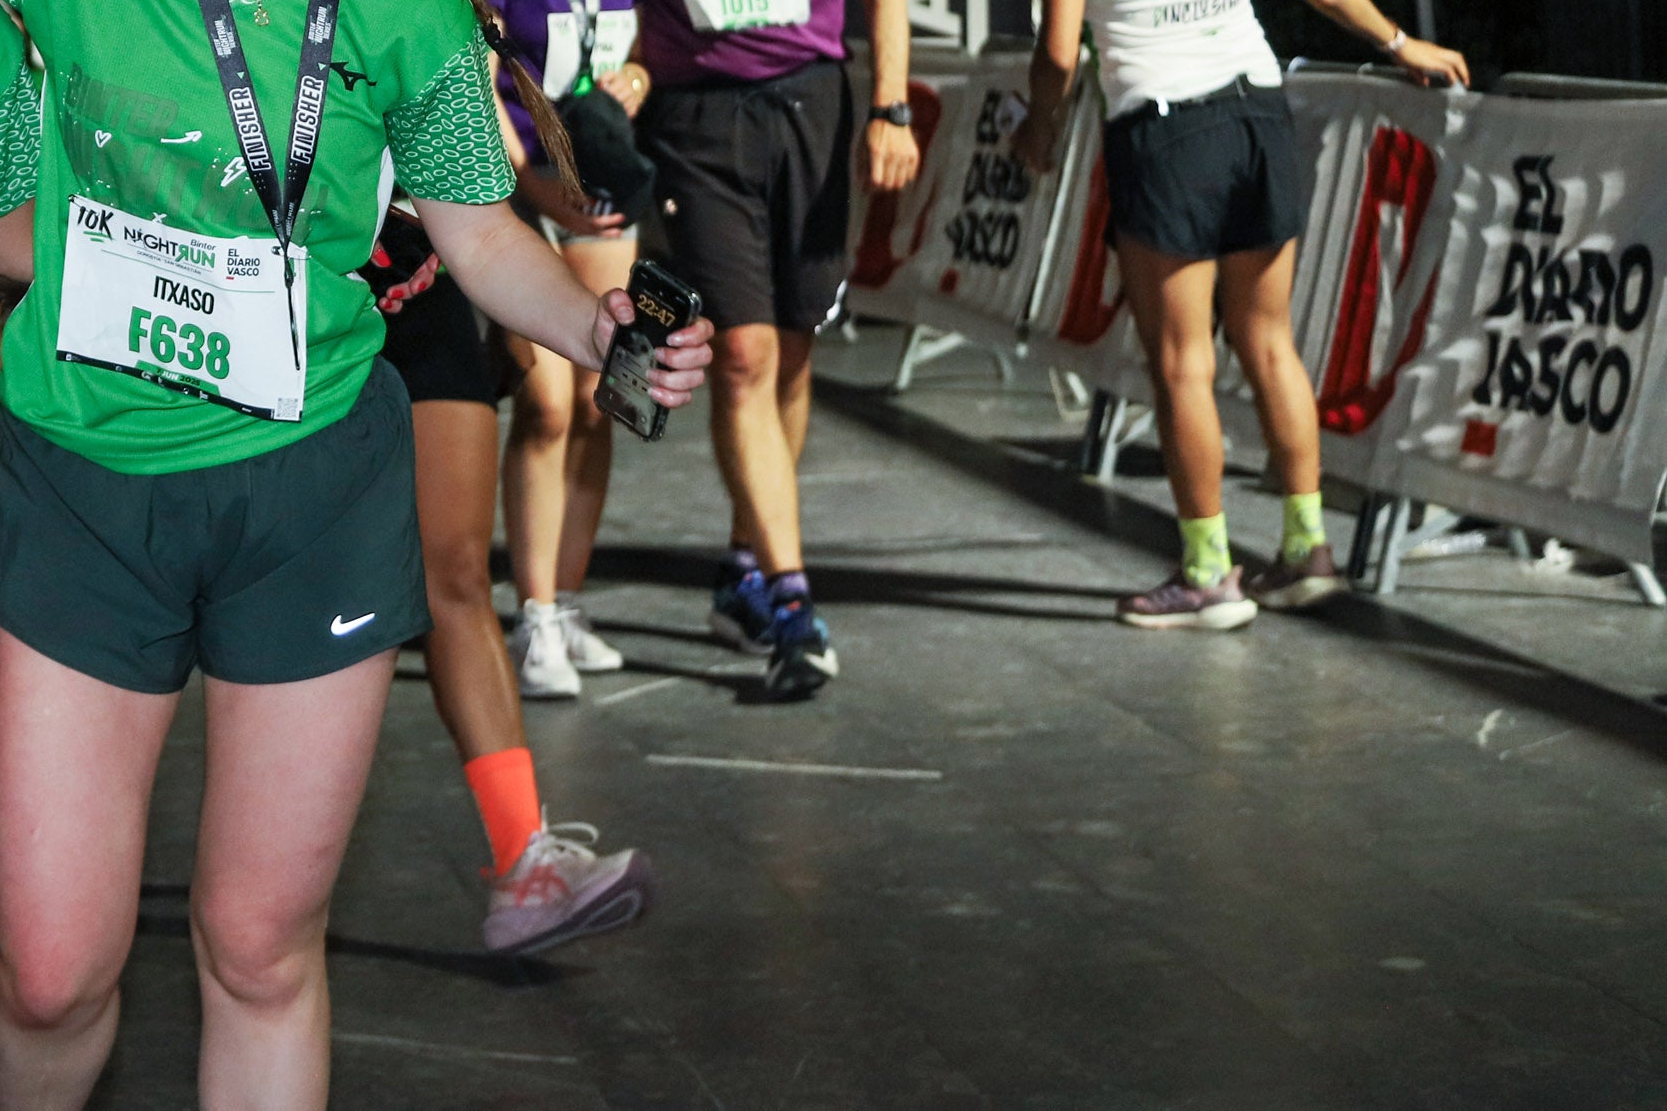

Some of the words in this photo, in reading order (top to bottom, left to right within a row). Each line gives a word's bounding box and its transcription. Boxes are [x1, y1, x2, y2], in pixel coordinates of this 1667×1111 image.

[229, 85, 272, 172] FINISHER
[290, 75, 324, 165] FINISHER
[77, 206, 114, 241] 10K
[227, 257, 260, 268] DIARIO
[228, 248, 240, 258] EL
[227, 266, 260, 277] VASCO
[153, 275, 215, 315] ITXASO
[637, 294, 677, 328] 22:47
[128, 305, 231, 380] F638
[162, 370, 179, 381] JUN
[180, 375, 201, 387] 2025
